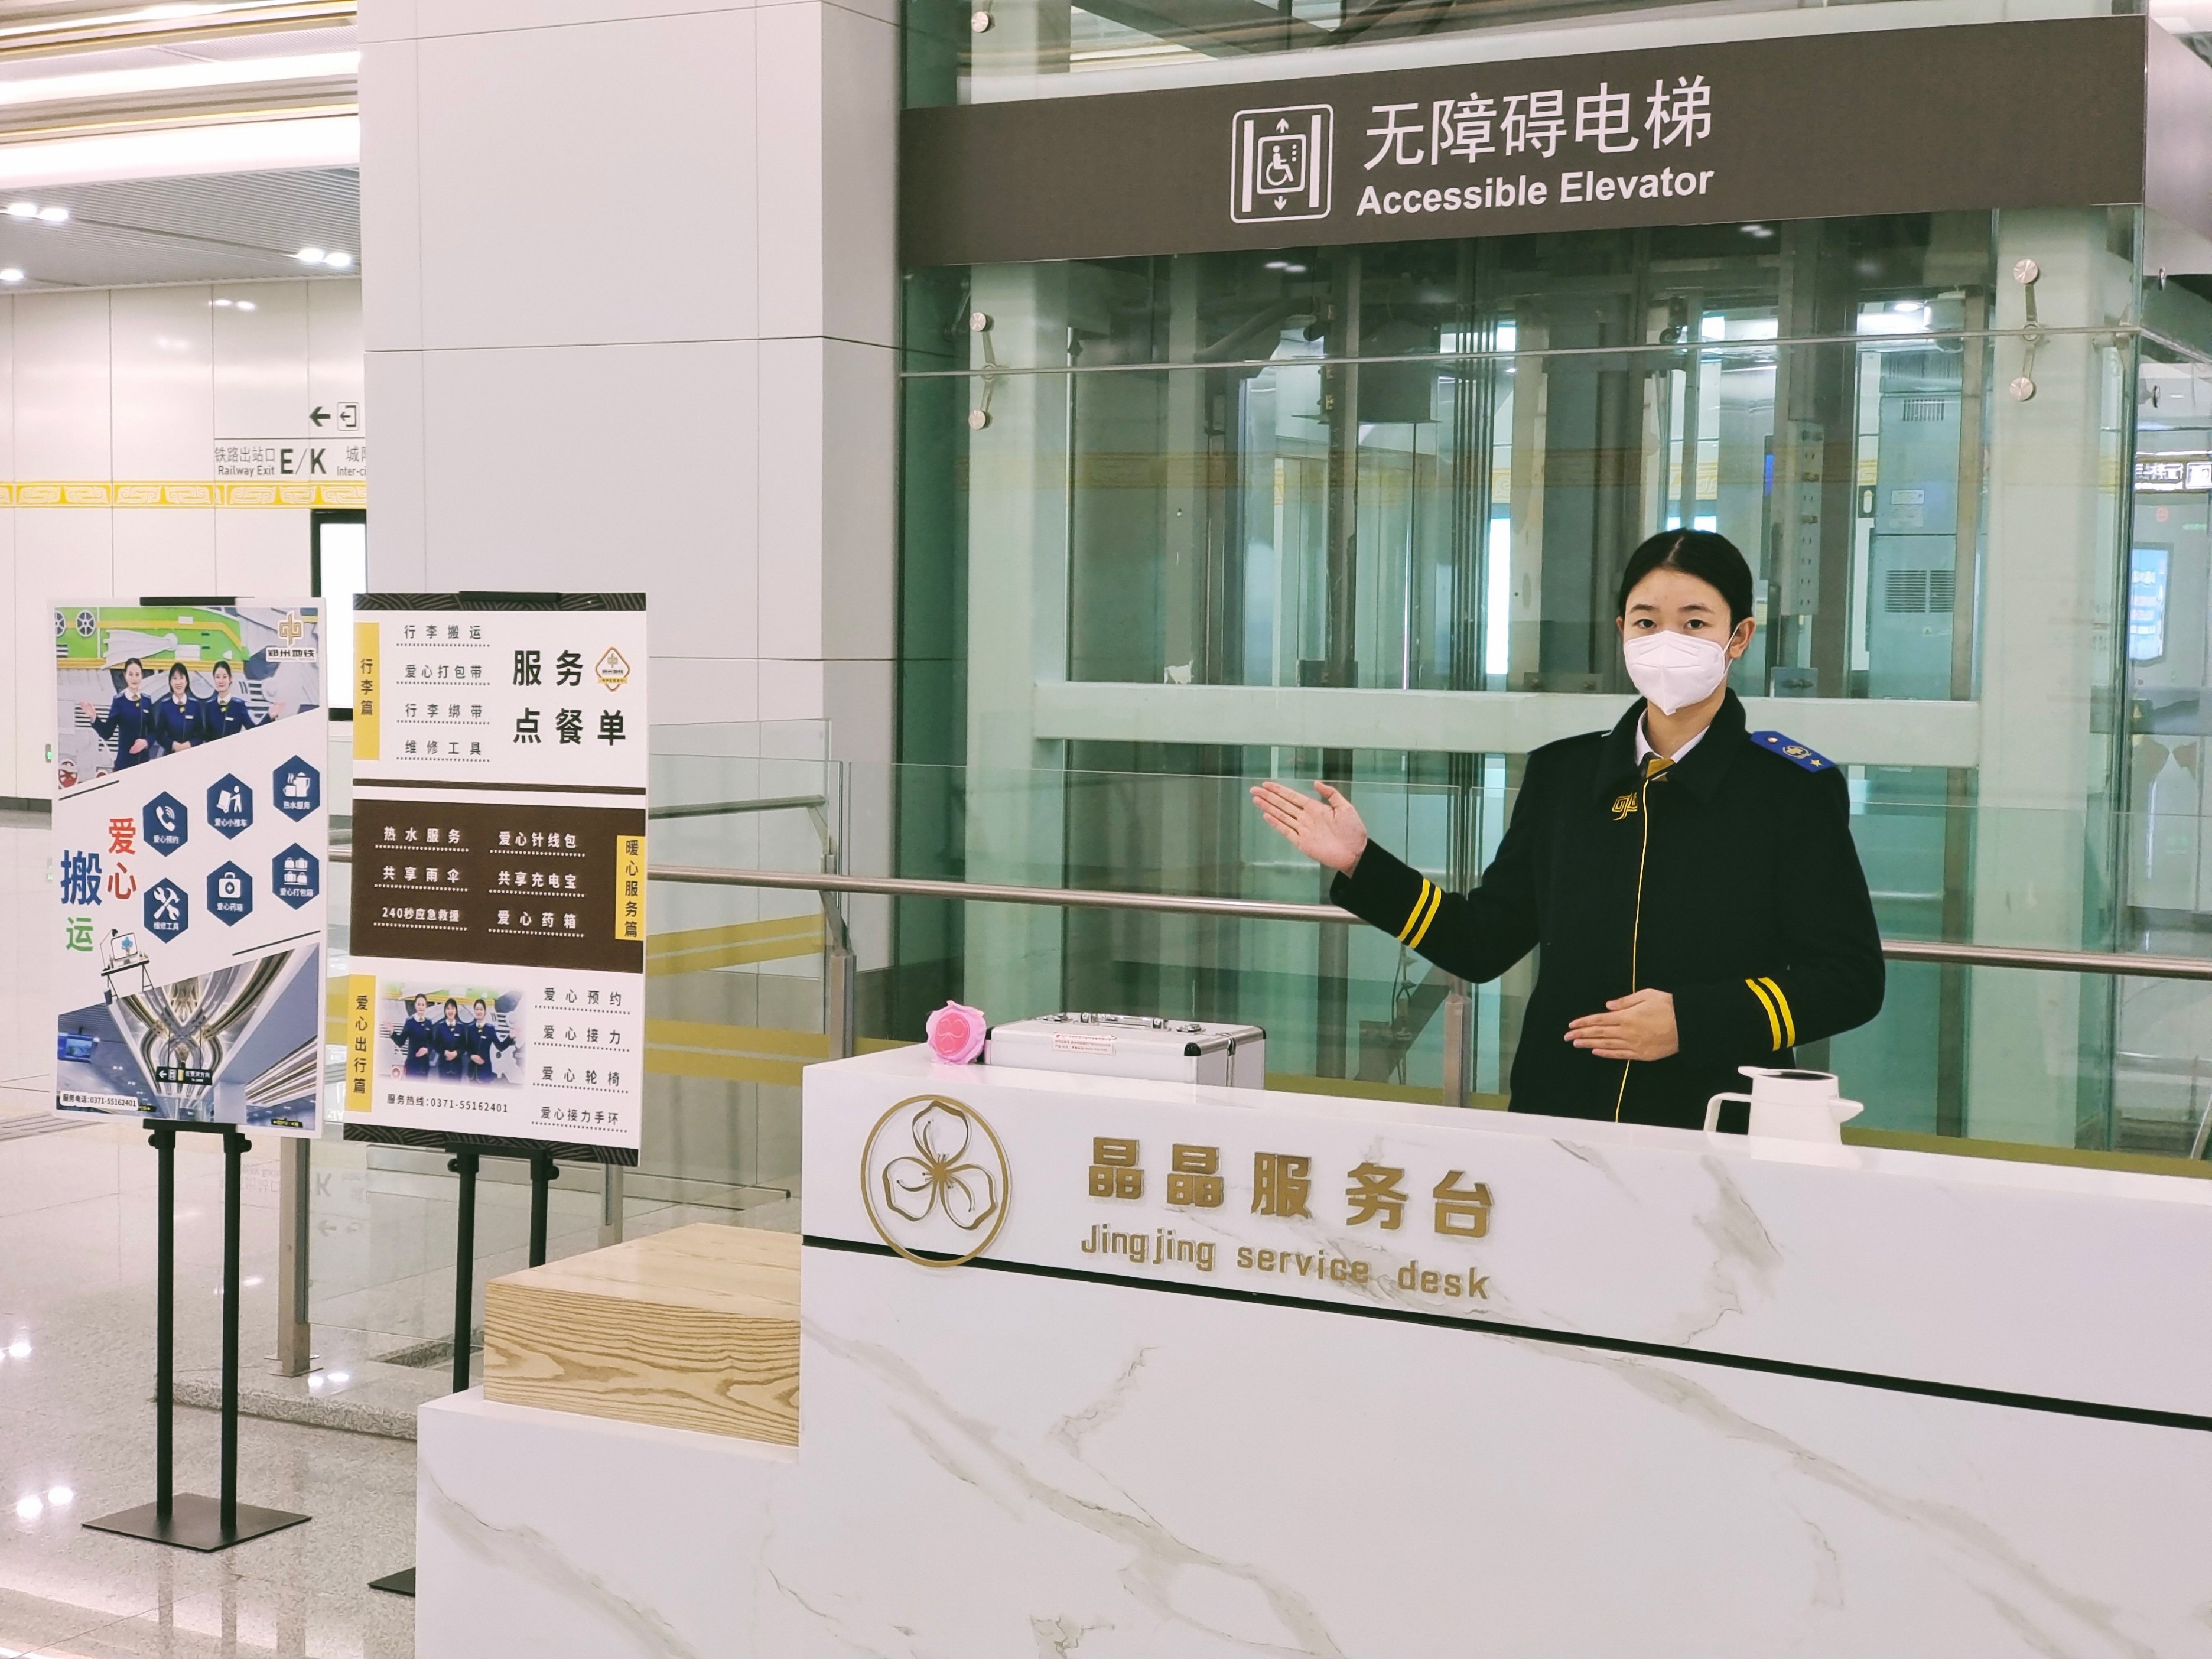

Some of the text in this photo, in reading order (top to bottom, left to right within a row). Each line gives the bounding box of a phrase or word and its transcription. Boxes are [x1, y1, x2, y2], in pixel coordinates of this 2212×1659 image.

[1362, 74, 1712, 171] 无障碍电梯
[1356, 166, 1715, 217] Accessible Elevator
[214, 446, 275, 463] 铁路出站口
[218, 465, 275, 478] Railway Exit
[404, 625, 482, 640] 行李搬运
[268, 649, 315, 658] 郑州地铁
[405, 664, 482, 679] 爱心打包带
[513, 649, 583, 687] 服务
[360, 658, 373, 717] 行李篇
[405, 704, 482, 718] 行李绑带
[513, 707, 626, 746] 点餐单
[405, 740, 482, 756] 维修工具
[383, 826, 461, 844] 热水服务
[499, 831, 577, 849] 爱心针线包
[107, 817, 137, 900] 爱心
[383, 866, 460, 883] 共享雨伞
[498, 871, 577, 889] 共享充电宝
[624, 840, 639, 938] 暖心服务篇
[382, 907, 459, 922] 240秒应急救援
[497, 910, 576, 929] 爱心药箱
[544, 987, 622, 1007] 爱心预约
[543, 1025, 621, 1045] 爱心接力
[353, 995, 369, 1095] 爱心出行篇
[542, 1066, 620, 1087] 爱心轮椅
[387, 1094, 508, 1113] 服务热线:0371-55162401
[540, 1106, 619, 1125] 爱心接力手环
[1088, 1136, 1492, 1238] 晶晶服务台
[1081, 1224, 1491, 1300] Jingjing service desk
